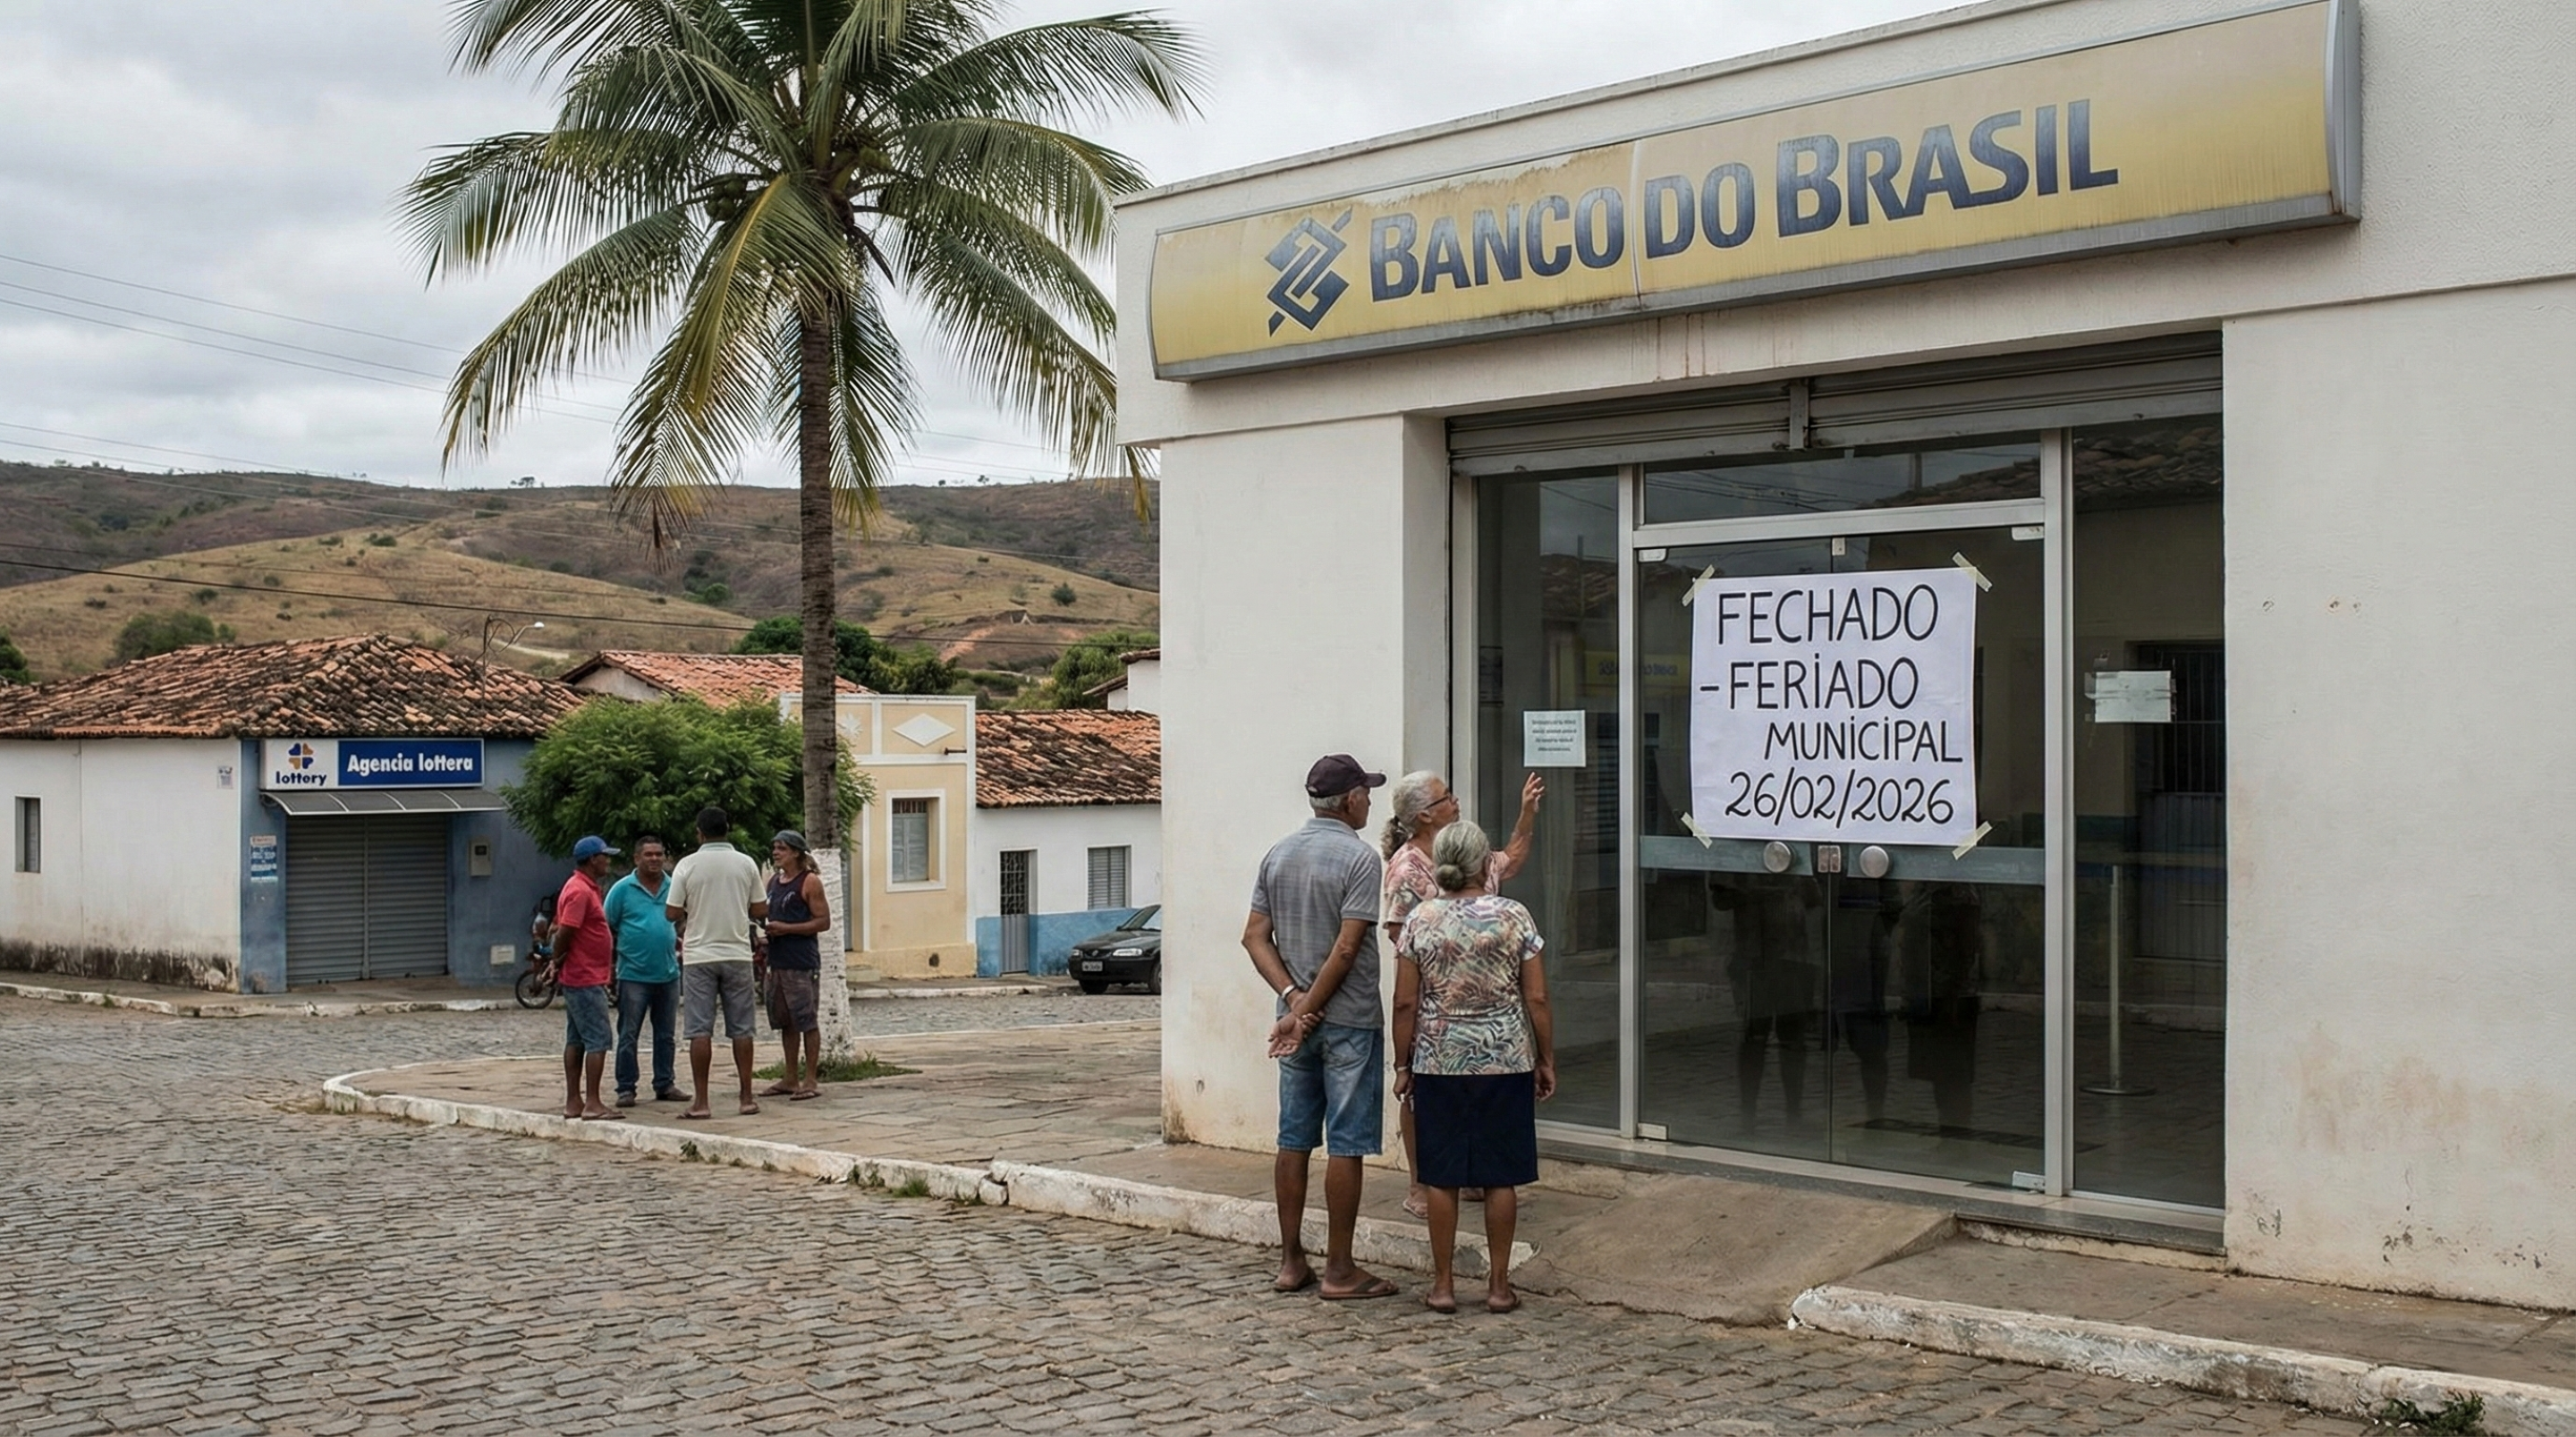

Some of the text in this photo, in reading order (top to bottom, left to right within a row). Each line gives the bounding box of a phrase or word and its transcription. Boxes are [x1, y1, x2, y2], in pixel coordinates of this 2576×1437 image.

[1370, 97, 2120, 301] BANCO DO BRASIL
[1717, 584, 1939, 645] FECHADO
[347, 753, 473, 777] Agencia lottera
[1764, 715, 1963, 763] MUNICIPAL
[1724, 766, 1954, 829] 26/02/2026
